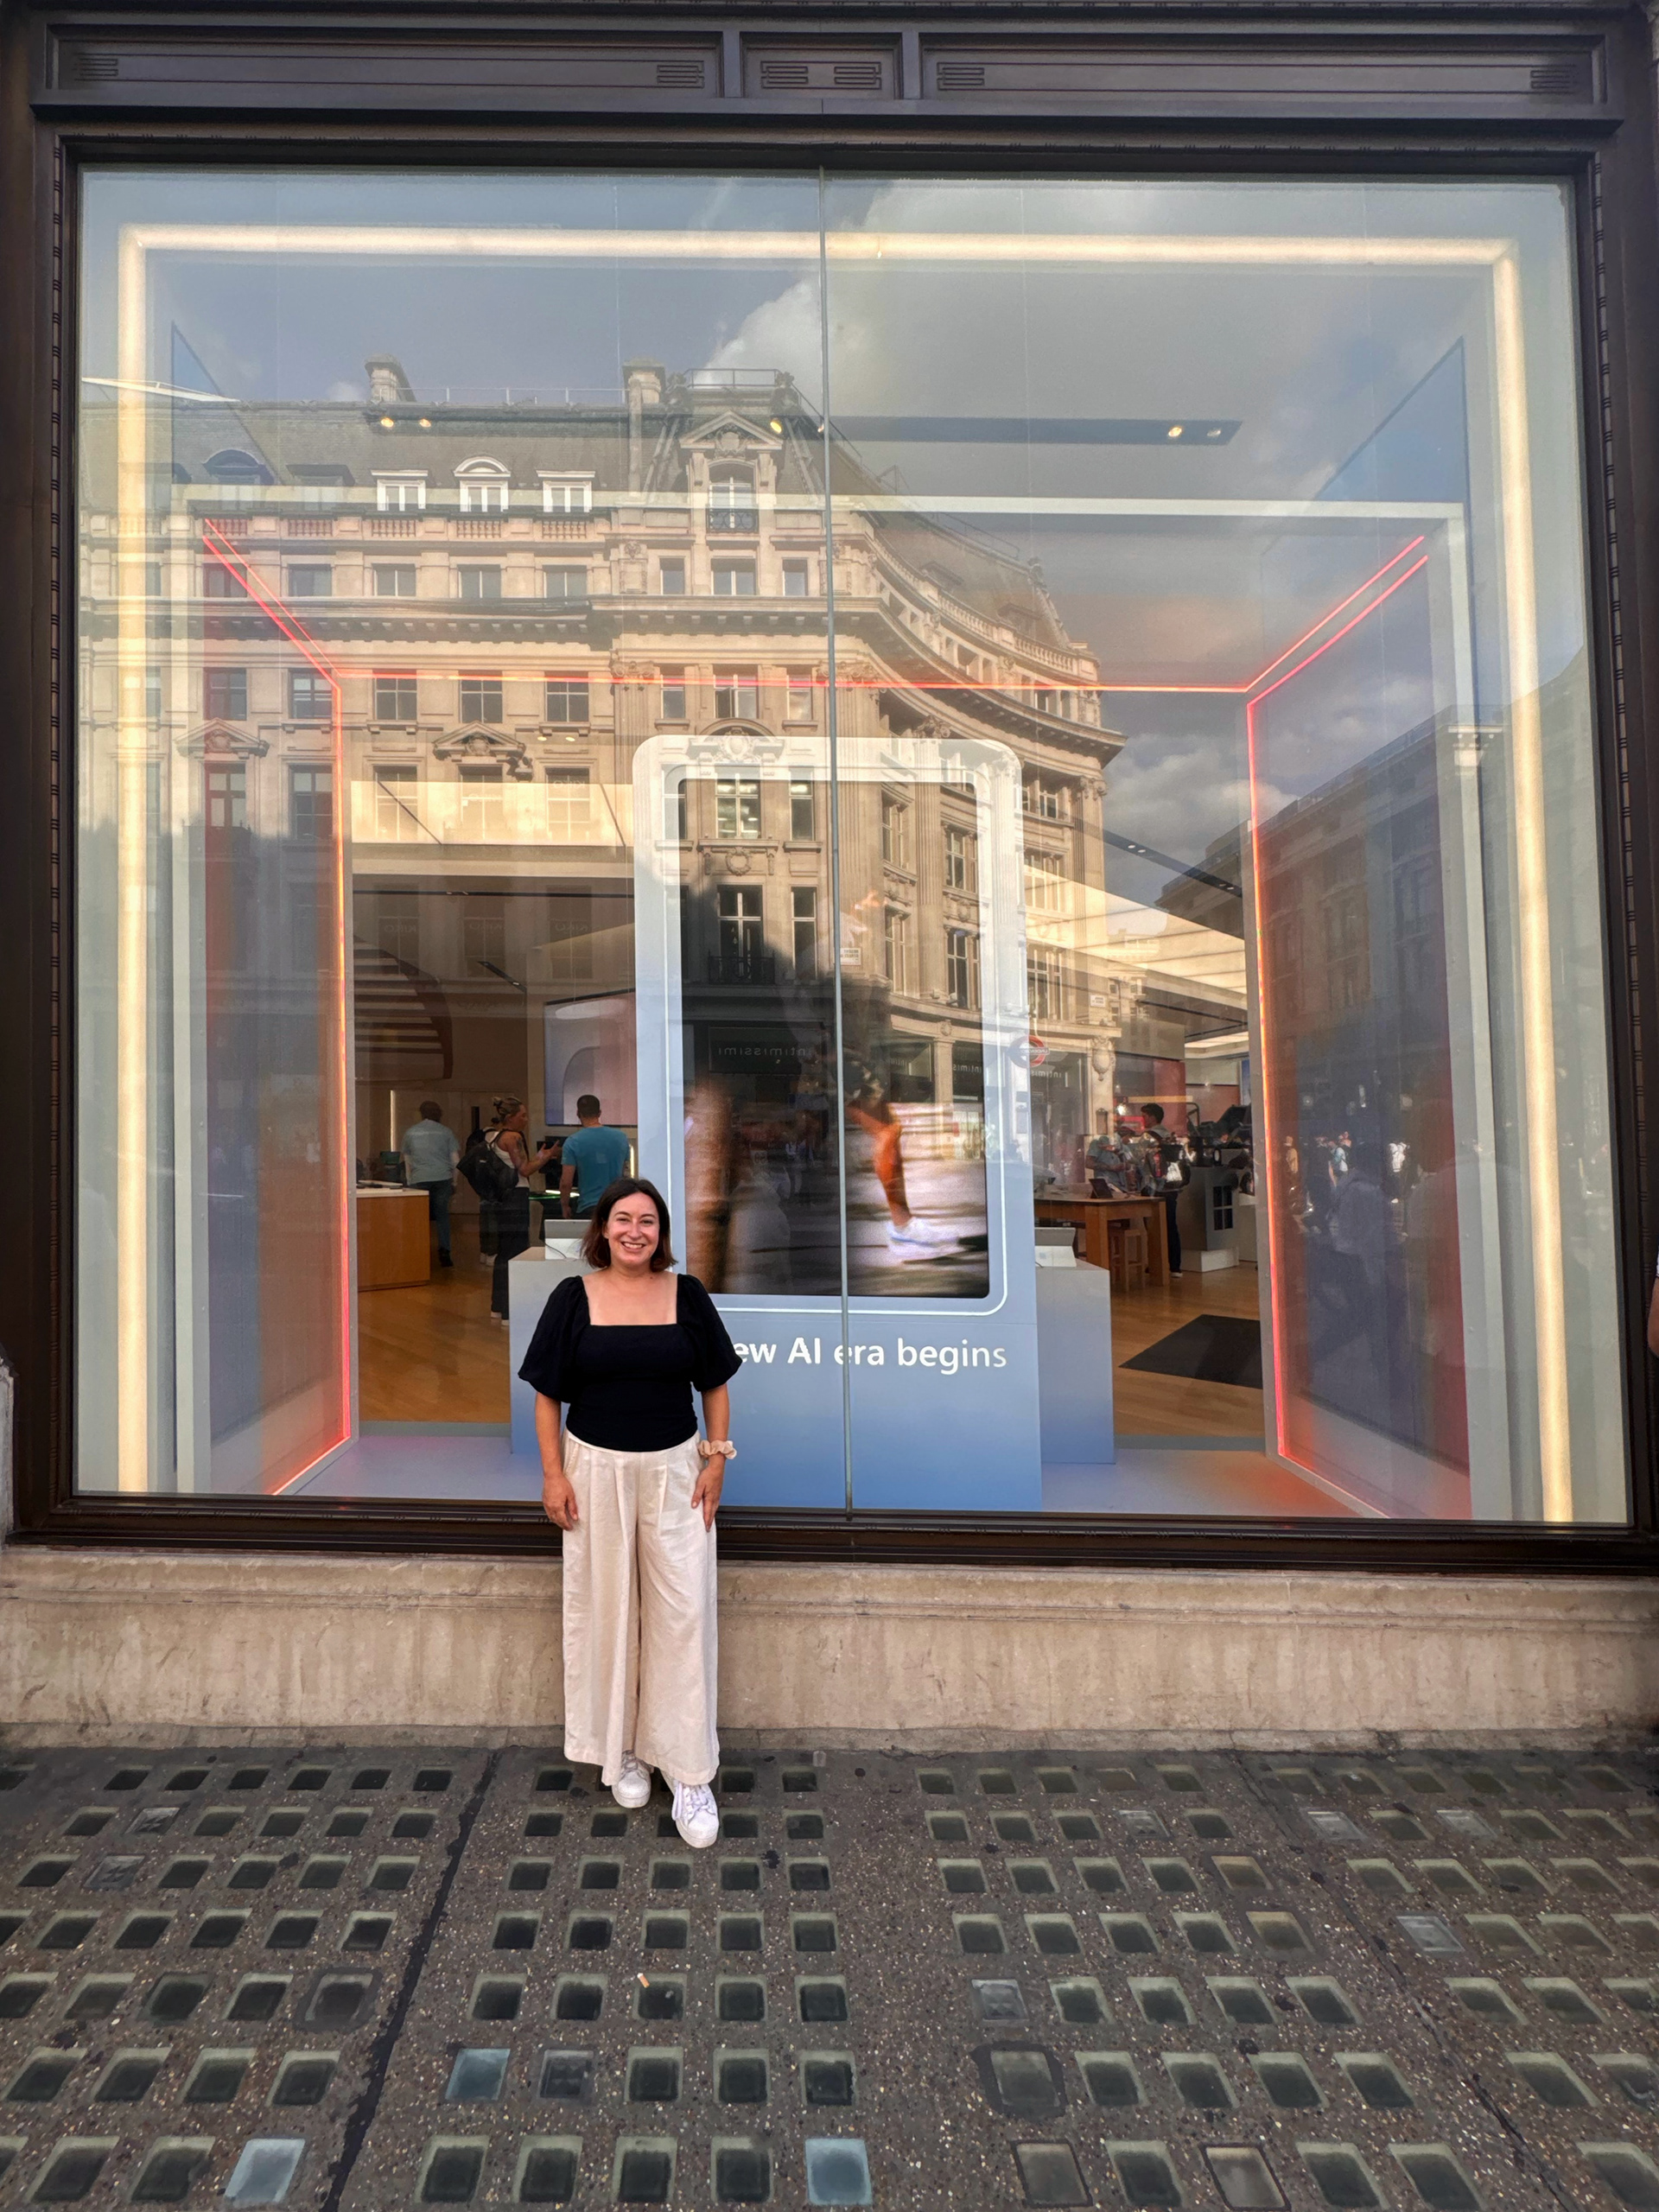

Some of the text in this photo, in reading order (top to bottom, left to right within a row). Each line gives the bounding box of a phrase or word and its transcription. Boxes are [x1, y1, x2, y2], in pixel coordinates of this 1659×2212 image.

[733, 1337, 1007, 1376] ew AI era begins
